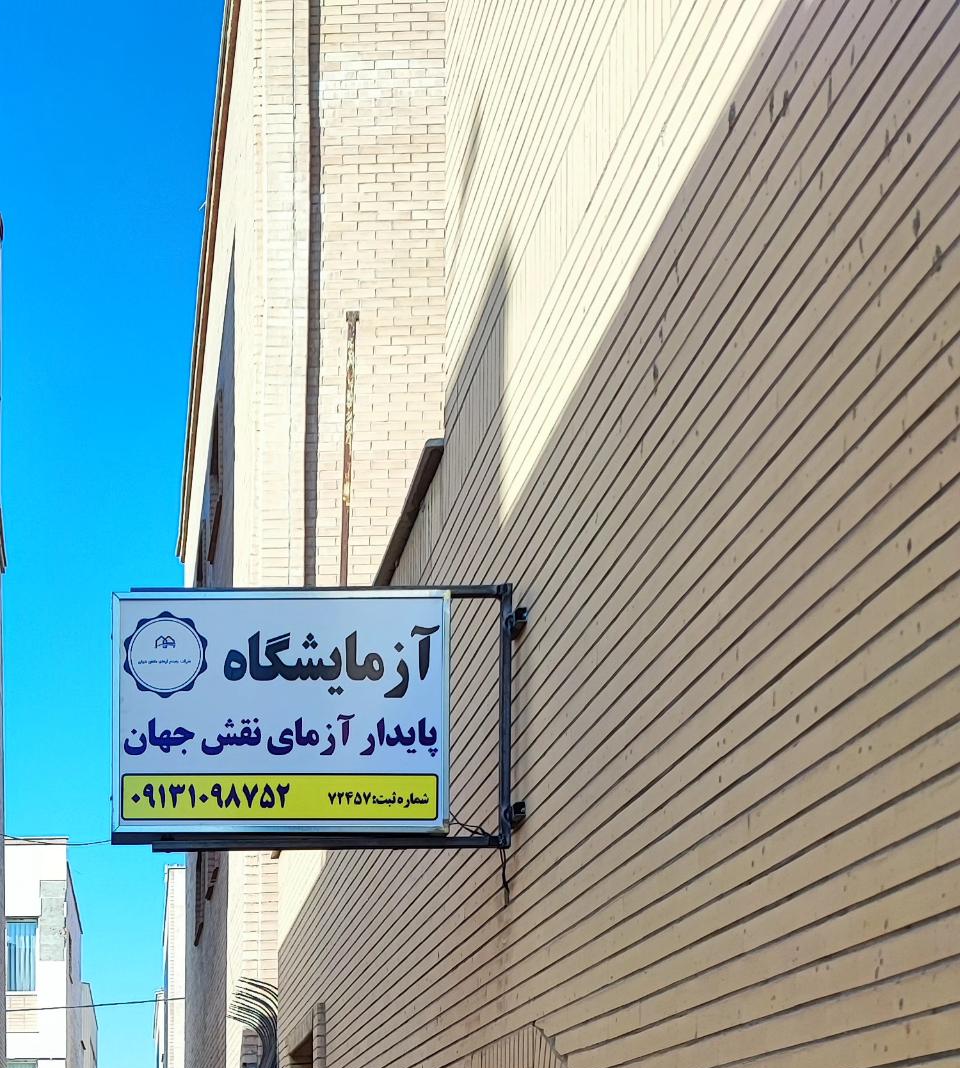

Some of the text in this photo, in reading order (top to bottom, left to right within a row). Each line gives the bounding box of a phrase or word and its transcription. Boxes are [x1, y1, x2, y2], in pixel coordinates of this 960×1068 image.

[223, 625, 441, 698] آزمایشگاه
[123, 713, 438, 758] پایدار آزمای نقش جهان
[131, 783, 290, 808] ۰۹۱۳۱۰۹۸۷۵۲
